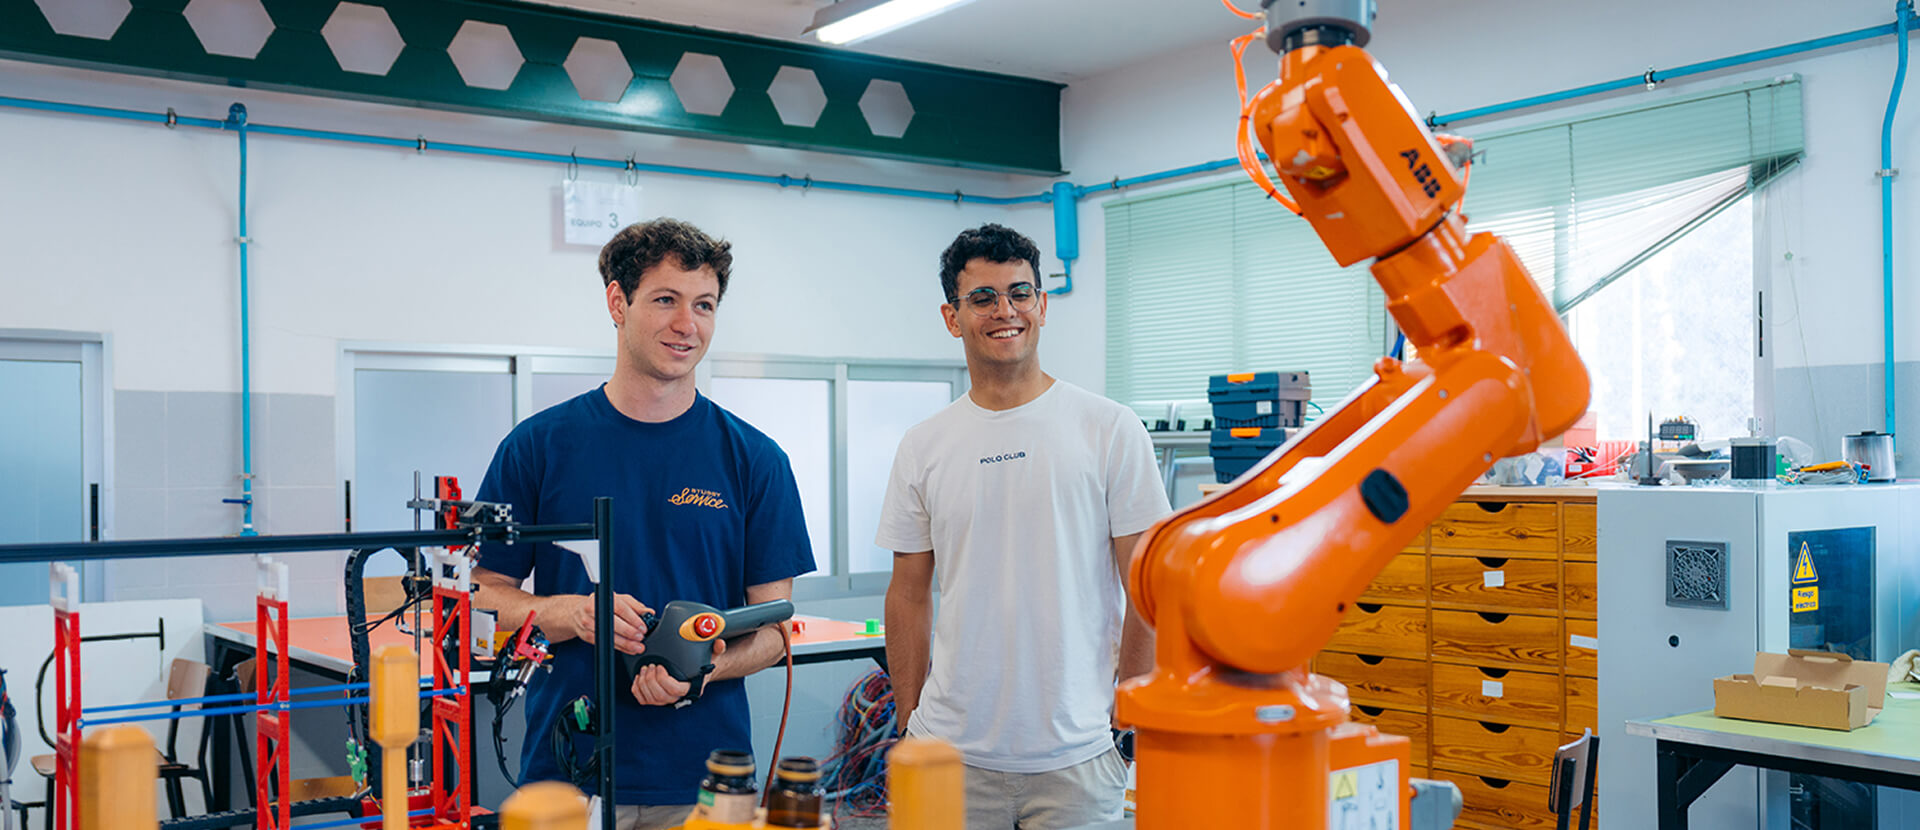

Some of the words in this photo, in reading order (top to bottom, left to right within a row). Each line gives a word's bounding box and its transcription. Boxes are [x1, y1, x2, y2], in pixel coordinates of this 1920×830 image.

[1400, 149, 1441, 198] ABB
[570, 218, 602, 228] EQUIPO
[608, 212, 619, 229] 3
[980, 455, 1003, 464] POLO
[1003, 451, 1026, 461] CLUB
[667, 487, 729, 509] Service
